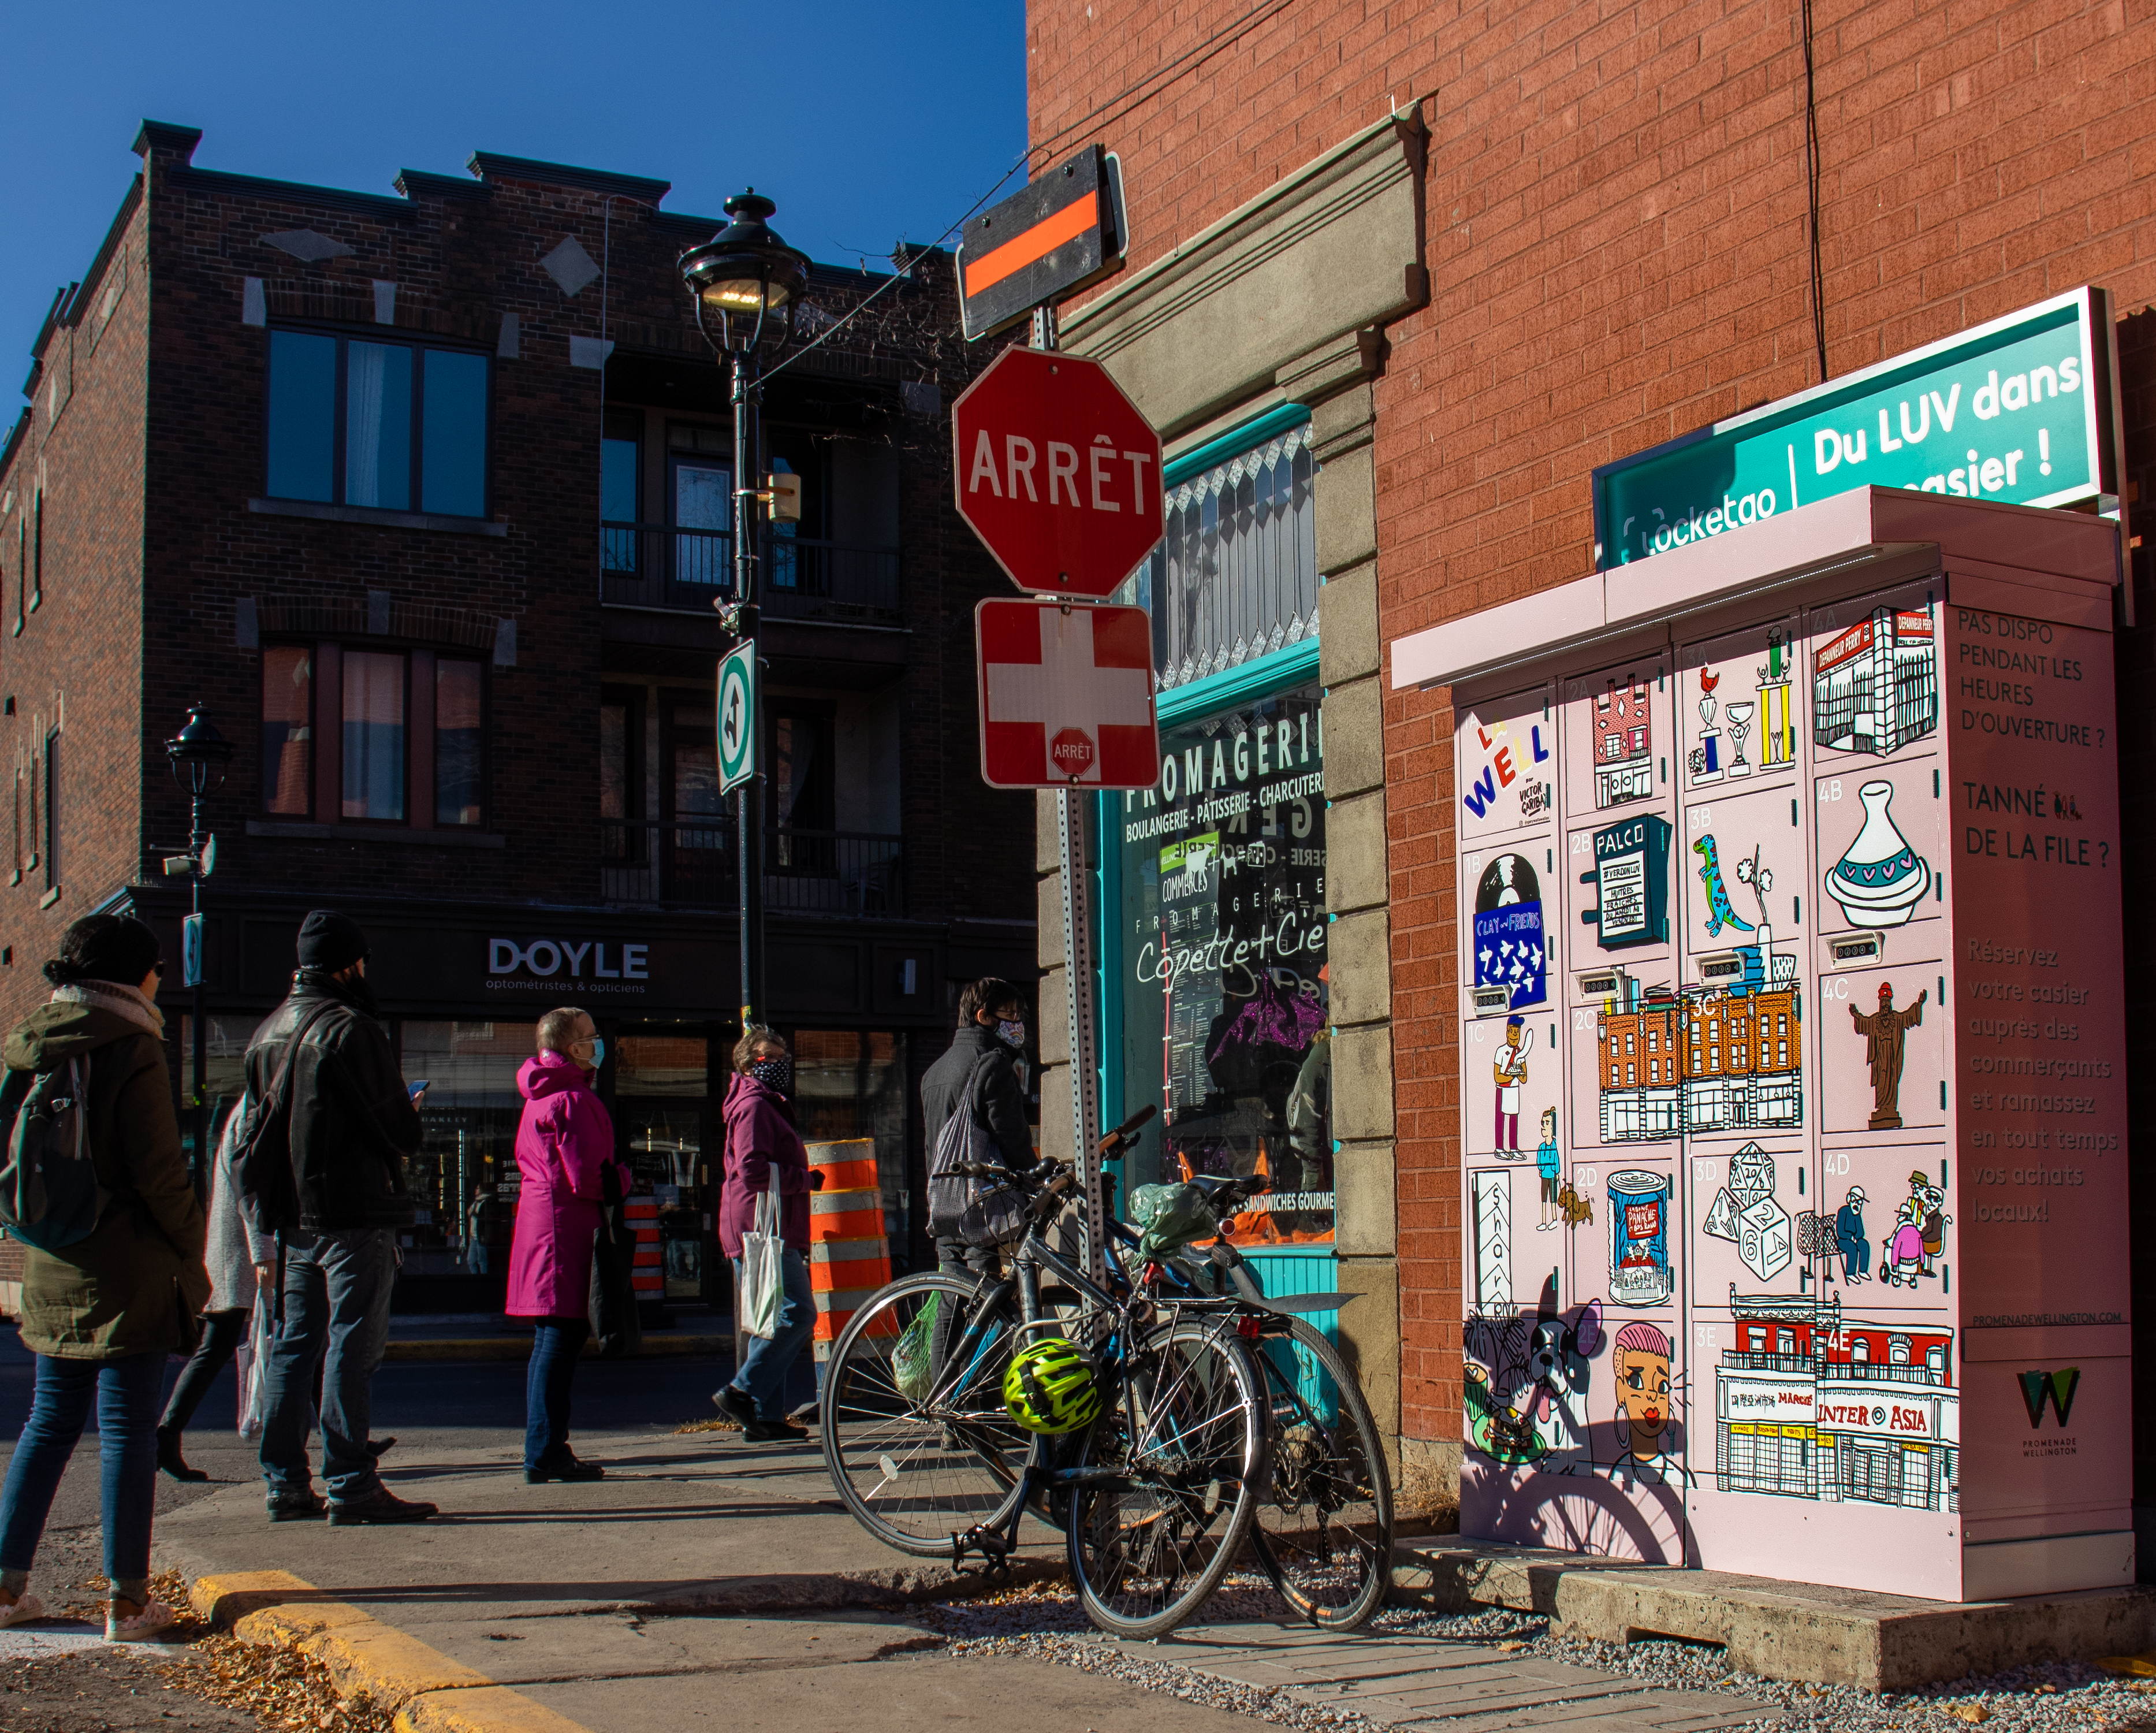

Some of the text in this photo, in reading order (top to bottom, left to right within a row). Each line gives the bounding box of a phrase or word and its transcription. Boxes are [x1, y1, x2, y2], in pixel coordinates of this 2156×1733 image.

[1814, 356, 2081, 475] Du LUV dans
[969, 429, 1150, 516] ARRÊT
[1902, 428, 2051, 497] asier !
[1958, 610, 2053, 644] PAS DISPO
[1845, 629, 1861, 654] PERRY
[1960, 643, 2083, 681] PENDANT LES
[1570, 679, 1588, 701] 2A
[1961, 676, 2034, 706] HEURES
[1963, 709, 2105, 748] D'OUVERTURE ?
[1054, 742, 1092, 761] ARRÊT
[1464, 725, 1550, 821] WELL
[1520, 782, 1542, 802] VICTOR
[1818, 780, 1842, 802] 4B
[1964, 782, 2046, 818] TANNÉ
[1126, 808, 1189, 843] BOULANGERIE
[1197, 791, 1250, 824] PÂTISSERIE
[1690, 808, 1712, 830] 3B
[1572, 833, 1591, 854] 2B
[1597, 824, 1643, 855] PALCO
[1967, 827, 2109, 868] DE LA FILE ?
[1465, 855, 1481, 875] 1B
[1163, 868, 1208, 902] COMMERCES
[1136, 877, 1323, 934] FROMAGERIE
[1477, 917, 1499, 936] CLAY
[1509, 912, 1540, 931] FRIENDS
[489, 938, 649, 979] DOYLE
[1968, 937, 2058, 967] Réservez
[486, 979, 645, 993] optométristes & opticiens
[1823, 977, 1848, 1001] 4C
[1969, 979, 2089, 1005] votre casier
[1693, 995, 1716, 1017] 3C
[1575, 1010, 1596, 1031] 2C
[1969, 1016, 2079, 1043] auprès des
[1469, 1025, 1485, 1042] 1C
[1971, 1054, 2112, 1080] commerçants
[1971, 1089, 2095, 1114] et ramassez
[1971, 1127, 2118, 1155] en tout temps
[1695, 1161, 1717, 1182] 3D
[1745, 1167, 1757, 1178] 20
[1826, 1154, 1850, 1176] 4D
[1972, 1162, 2083, 1187] vos achats
[1577, 1167, 1598, 1188] 2D
[1244, 1193, 1296, 1213] SANDWICHES
[1298, 1192, 1334, 1211] GOURME
[1972, 1198, 2049, 1222] locaux!
[1628, 1209, 1656, 1226] PANACHE
[1753, 1204, 1774, 1226] 2
[1742, 1229, 1759, 1261] 6
[1973, 1312, 2121, 1327] PROMENADEWELLINGTON.COM
[1696, 1327, 1716, 1348] 3E
[1827, 1330, 1850, 1352] 4E
[1818, 1404, 1927, 1432] INTER ASIA
[2023, 1438, 2076, 1448] PROMENADE
[2023, 1448, 2076, 1458] WELLINGTON
